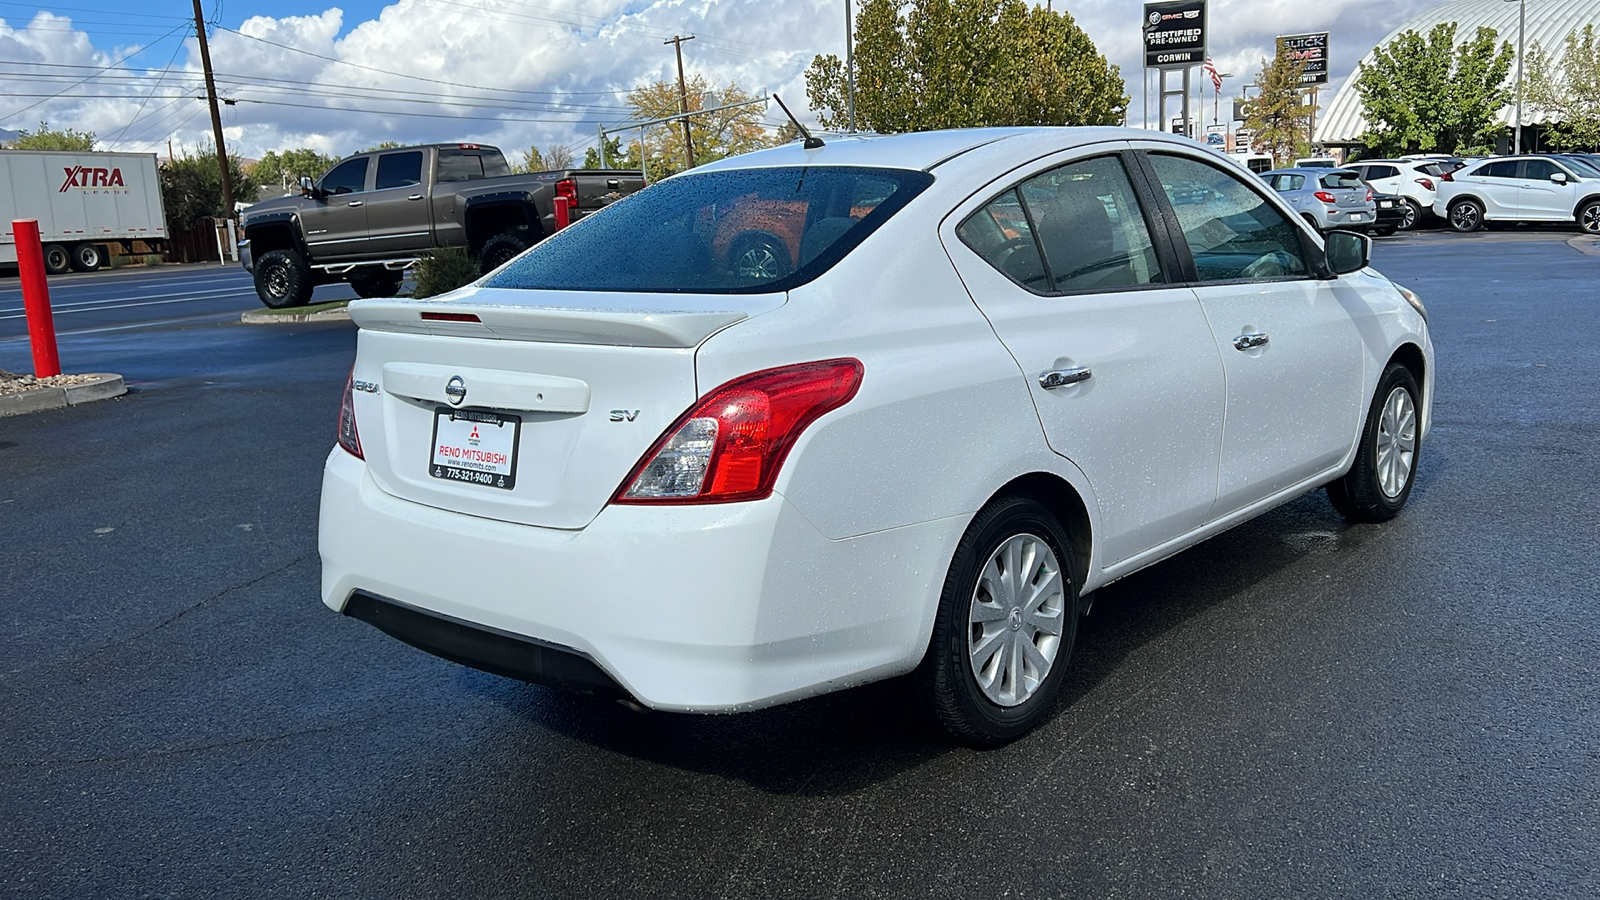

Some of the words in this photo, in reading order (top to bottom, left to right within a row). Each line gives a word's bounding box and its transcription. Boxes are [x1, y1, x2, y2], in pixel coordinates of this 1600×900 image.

[1147, 28, 1202, 39] CERTIFIED
[1150, 35, 1198, 45] PRE-OWNED
[1157, 53, 1191, 63] CORWIN
[59, 165, 125, 193] XTRA
[454, 410, 468, 420] RENO
[468, 412, 498, 423] MITSUBISHI
[609, 409, 640, 422] SV
[439, 445, 460, 458] RENO
[461, 448, 507, 465] MITSUBISHI
[447, 459, 497, 471] www.renomits.com
[446, 468, 493, 484] 775-321-9400
